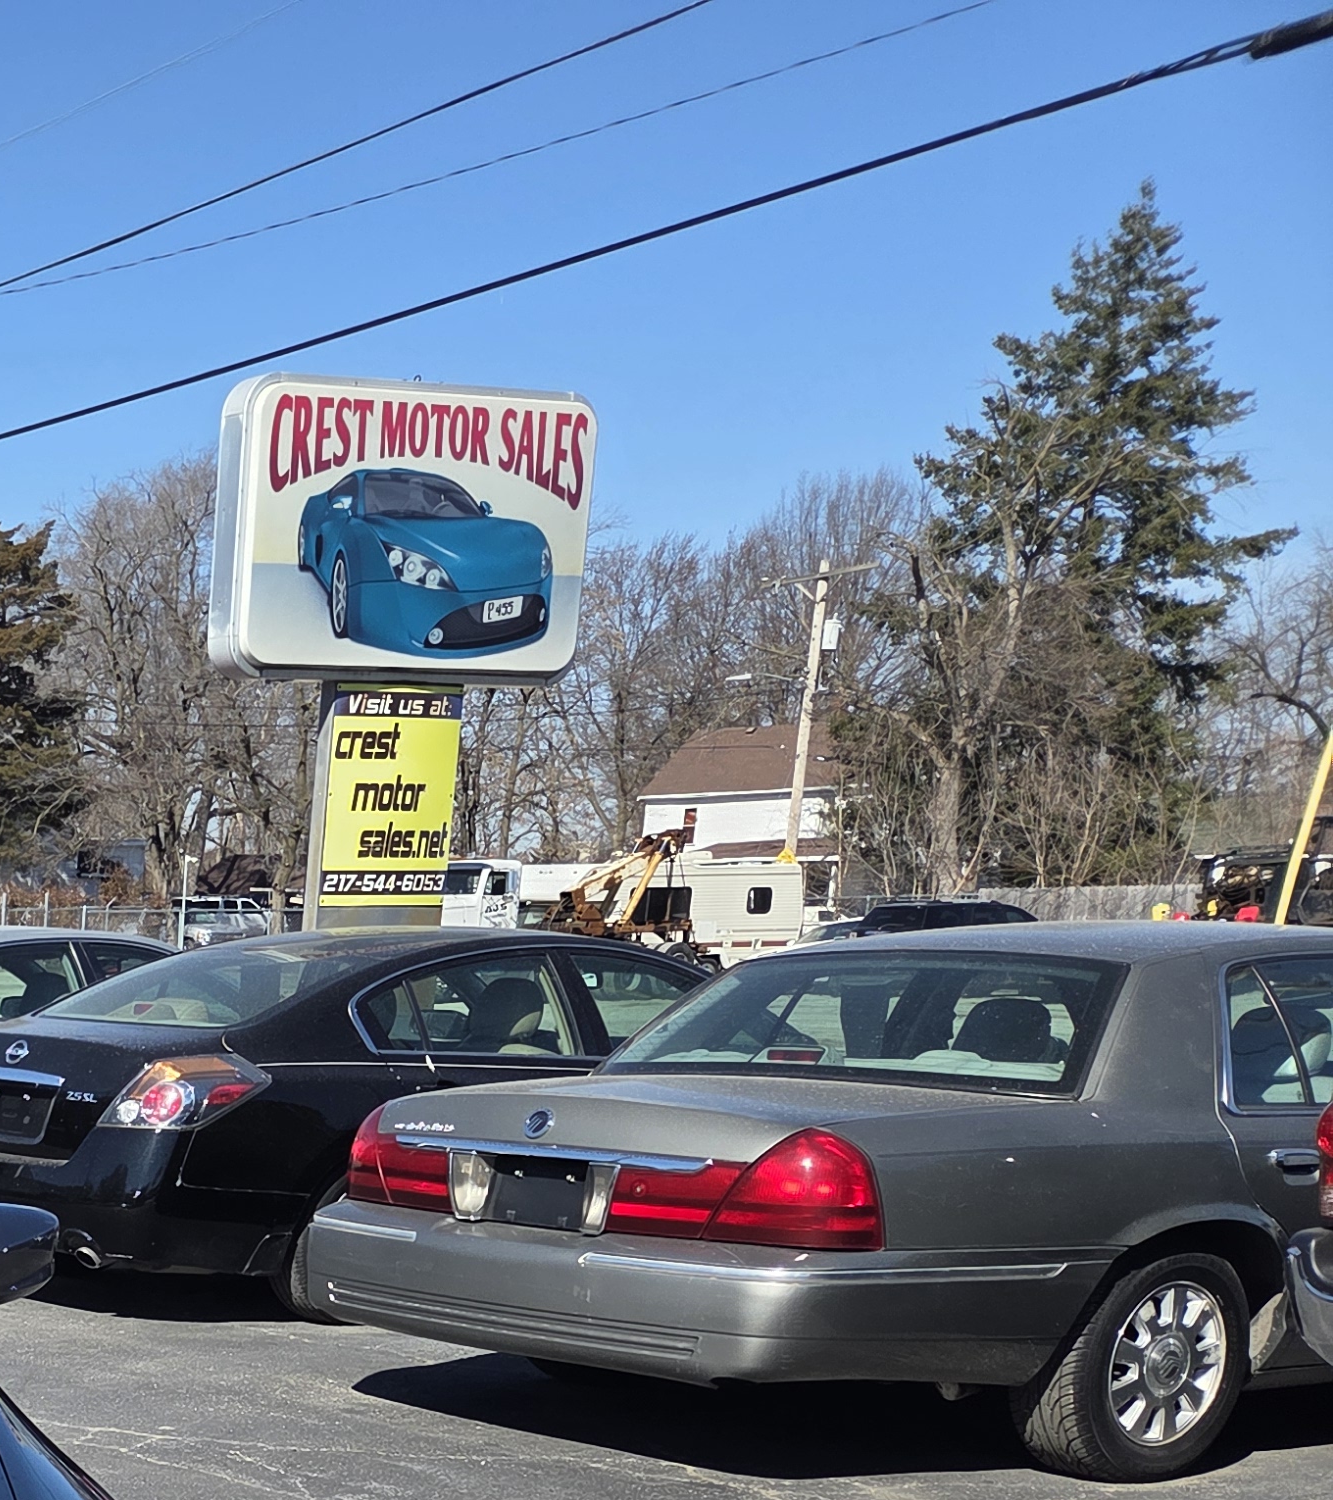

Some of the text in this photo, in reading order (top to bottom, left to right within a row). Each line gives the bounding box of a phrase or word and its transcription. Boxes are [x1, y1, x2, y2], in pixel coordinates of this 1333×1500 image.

[269, 393, 589, 511] CREST MOTOR SALES
[348, 694, 453, 716] Visit us at:
[334, 722, 401, 760] crest
[351, 774, 426, 812] motor
[357, 821, 448, 858] sales.net
[322, 873, 446, 893] 217-544-6053
